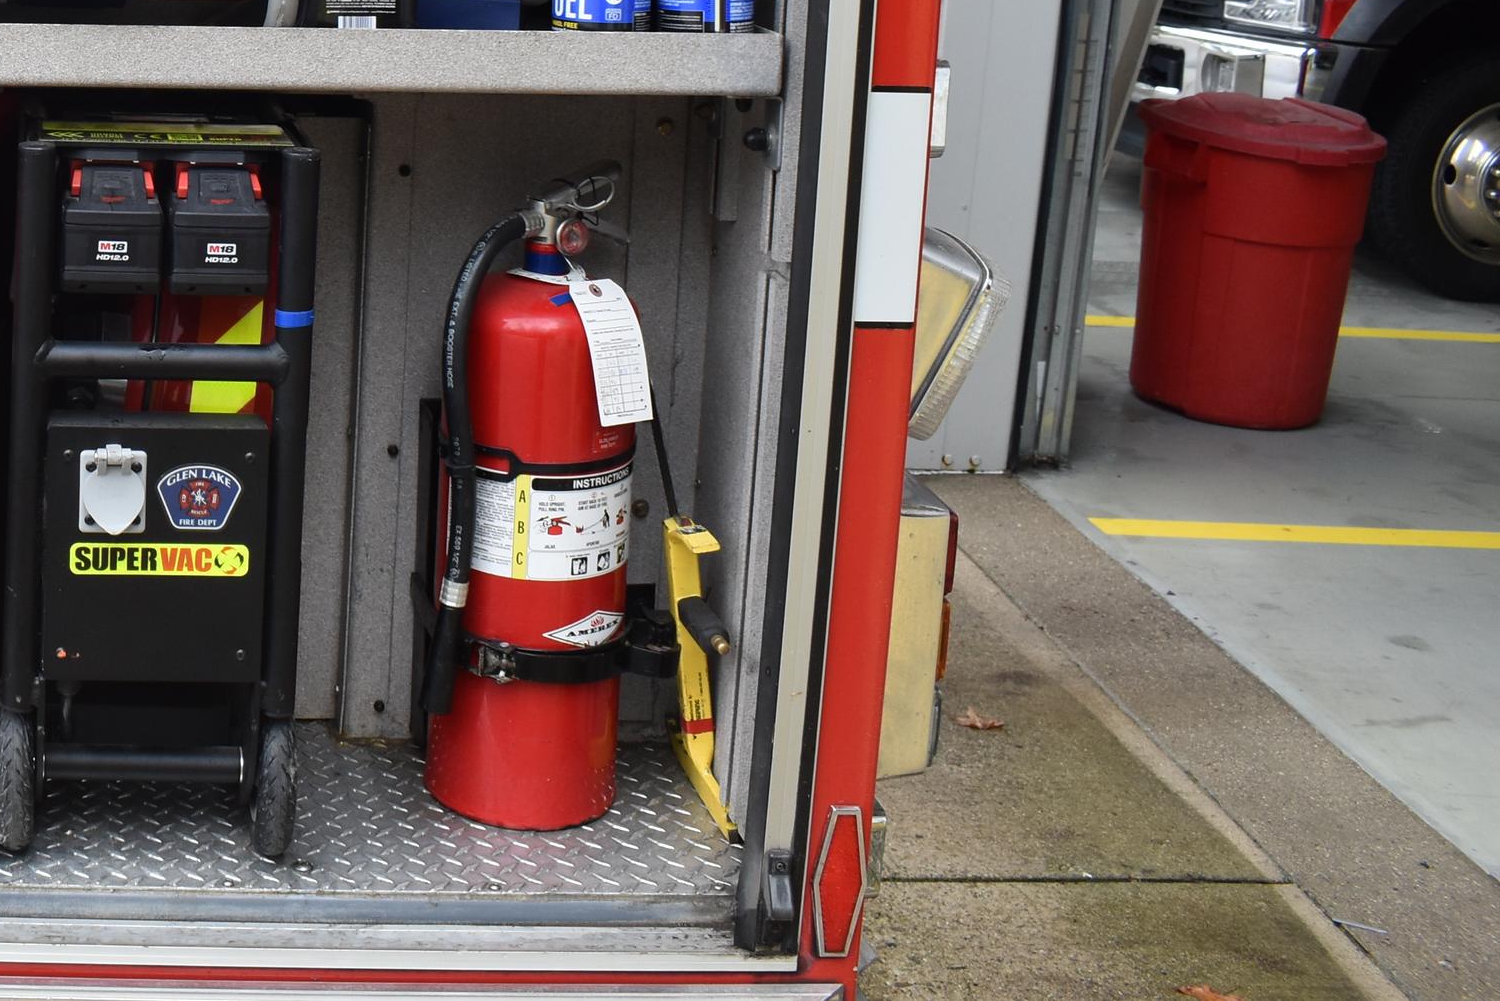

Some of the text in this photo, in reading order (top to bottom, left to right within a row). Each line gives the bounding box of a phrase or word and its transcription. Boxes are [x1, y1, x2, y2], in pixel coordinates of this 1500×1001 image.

[100, 242, 126, 251] M18
[208, 245, 234, 254] M18
[205, 256, 238, 264] HD12.0
[446, 328, 456, 365] BOOSTER
[166, 469, 232, 489] GLEN LAKE
[573, 466, 629, 489] INSTRUCTIONS
[518, 490, 526, 503] A
[518, 521, 525, 534] B
[516, 552, 523, 565] C
[567, 618, 619, 638] AMEREX
